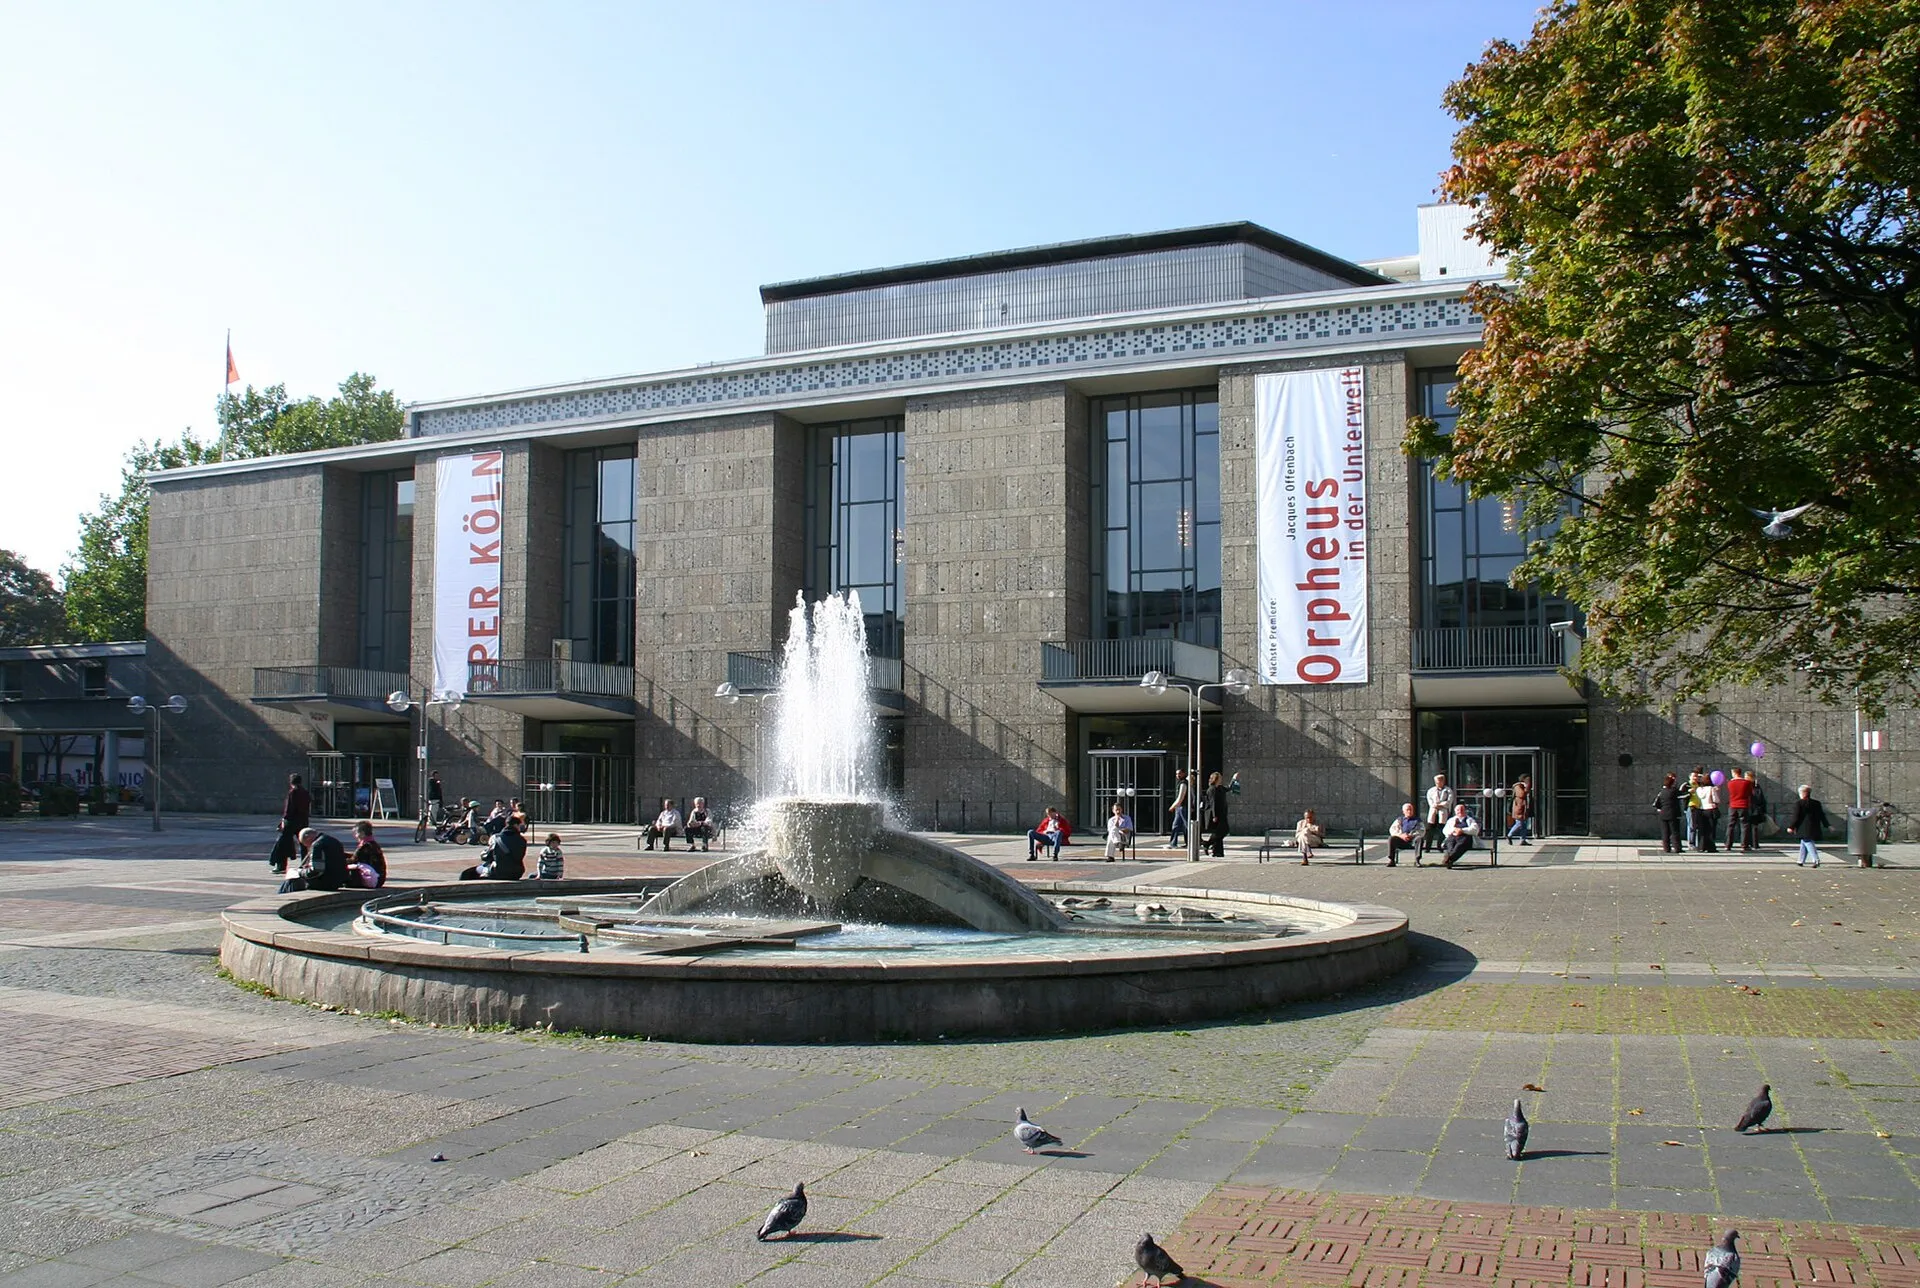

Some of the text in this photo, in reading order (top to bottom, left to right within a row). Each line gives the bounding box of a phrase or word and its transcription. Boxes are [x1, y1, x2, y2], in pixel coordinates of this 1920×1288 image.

[462, 451, 501, 565] KÖLN
[1284, 435, 1298, 541] Jacques Offenbach
[1341, 368, 1365, 561] in der Unterwelt
[1269, 597, 1277, 677] Nächste Premiere:
[1295, 477, 1352, 684] Orpheus
